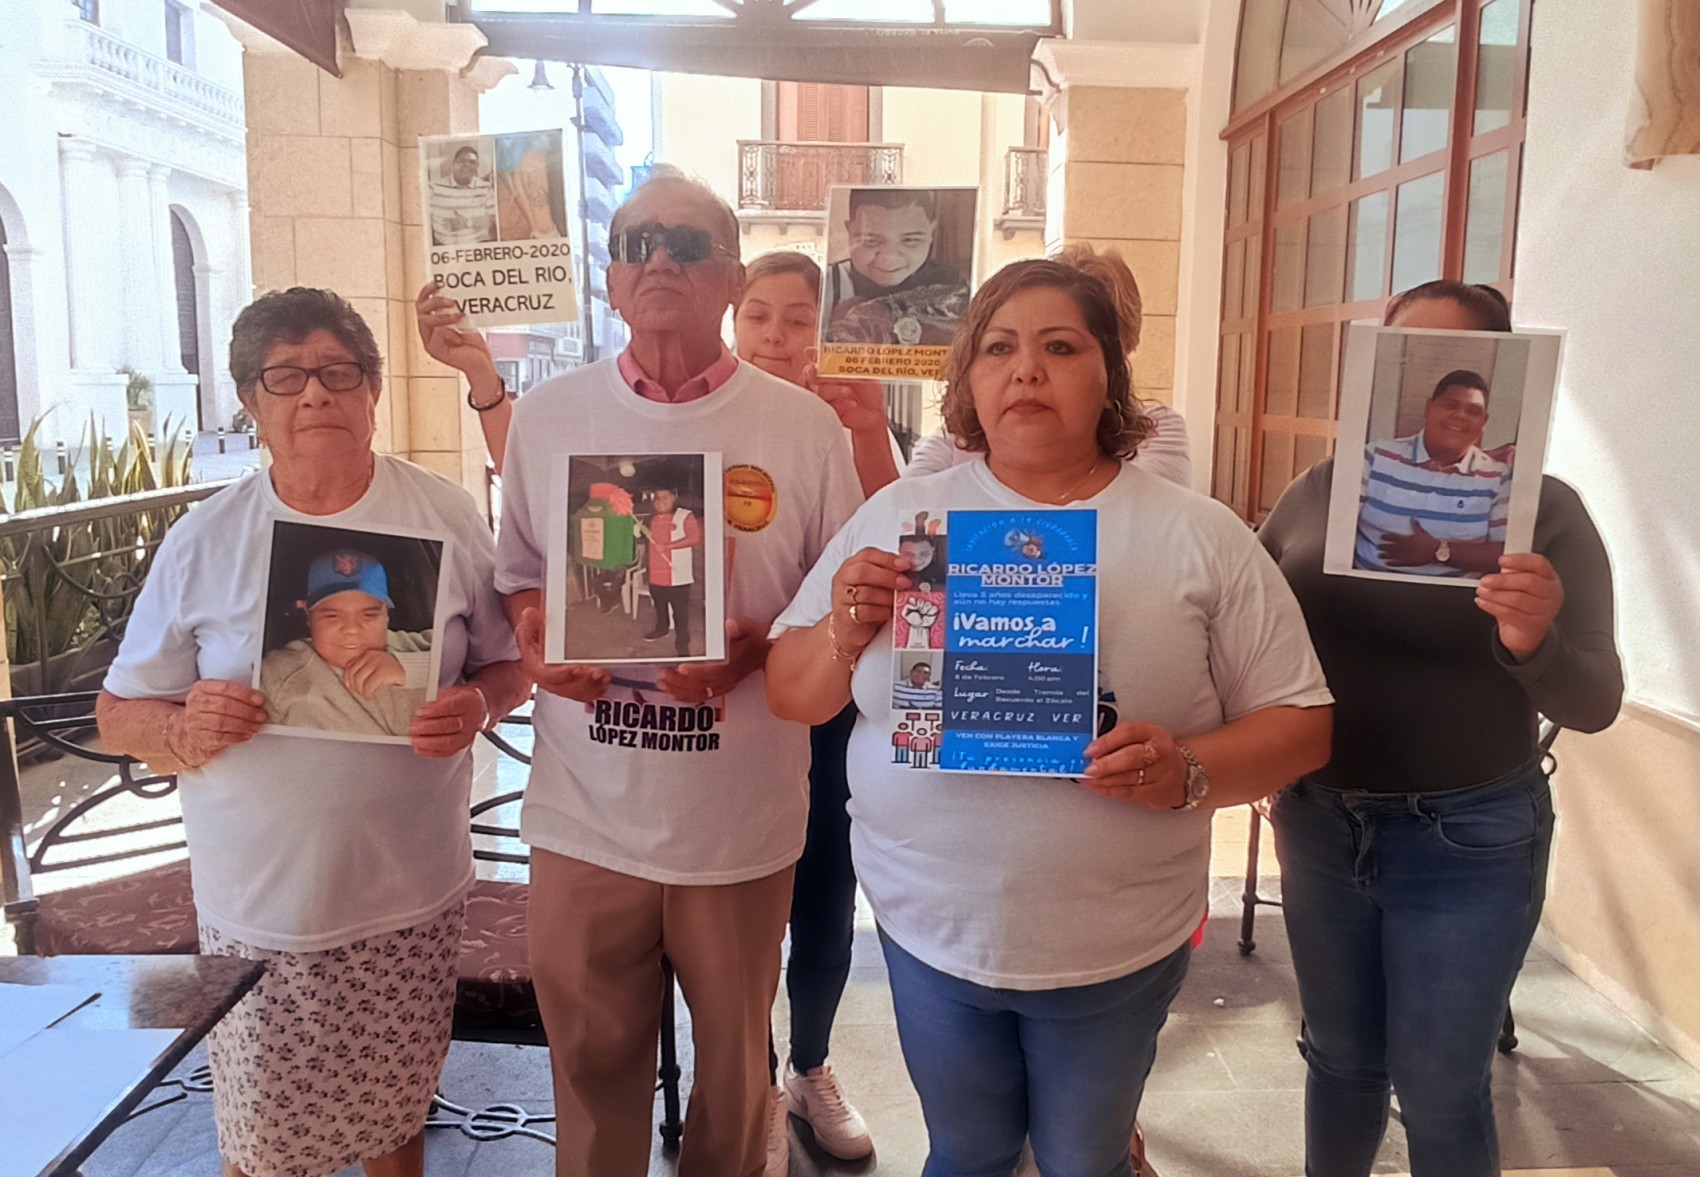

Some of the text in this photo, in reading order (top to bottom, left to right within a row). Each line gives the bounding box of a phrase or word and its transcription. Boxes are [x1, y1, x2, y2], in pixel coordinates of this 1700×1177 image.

[430, 243, 571, 265] 06-FEBRERO-2020
[434, 265, 572, 289] BOCA DEL RIO,
[454, 293, 555, 315] VERACRUZ
[823, 346, 875, 355] RICARDO
[914, 348, 948, 357] MONT
[845, 356, 859, 365] 06
[860, 357, 912, 366] FEBRERO
[838, 365, 870, 374] BOCA
[872, 366, 893, 374] DEL
[1010, 516, 1016, 524] A
[949, 561, 1098, 575] RICARDO LÓPEZ
[981, 574, 1063, 586] MONTOR
[953, 590, 1089, 601] Lleva 5 años desaparecido y
[988, 599, 1006, 607] hay
[953, 612, 1056, 632] ¡Vamos a
[958, 627, 1074, 648] marchar
[995, 696, 1034, 704] Recuerdo
[594, 699, 714, 733] RICARDO
[588, 723, 720, 752] LÓPEZ MONTOR
[975, 732, 993, 740] CON
[995, 733, 1034, 741] PLAYERA
[1036, 734, 1071, 742] BLANCA
[984, 741, 1049, 750] EXIGE JUSTICIA
